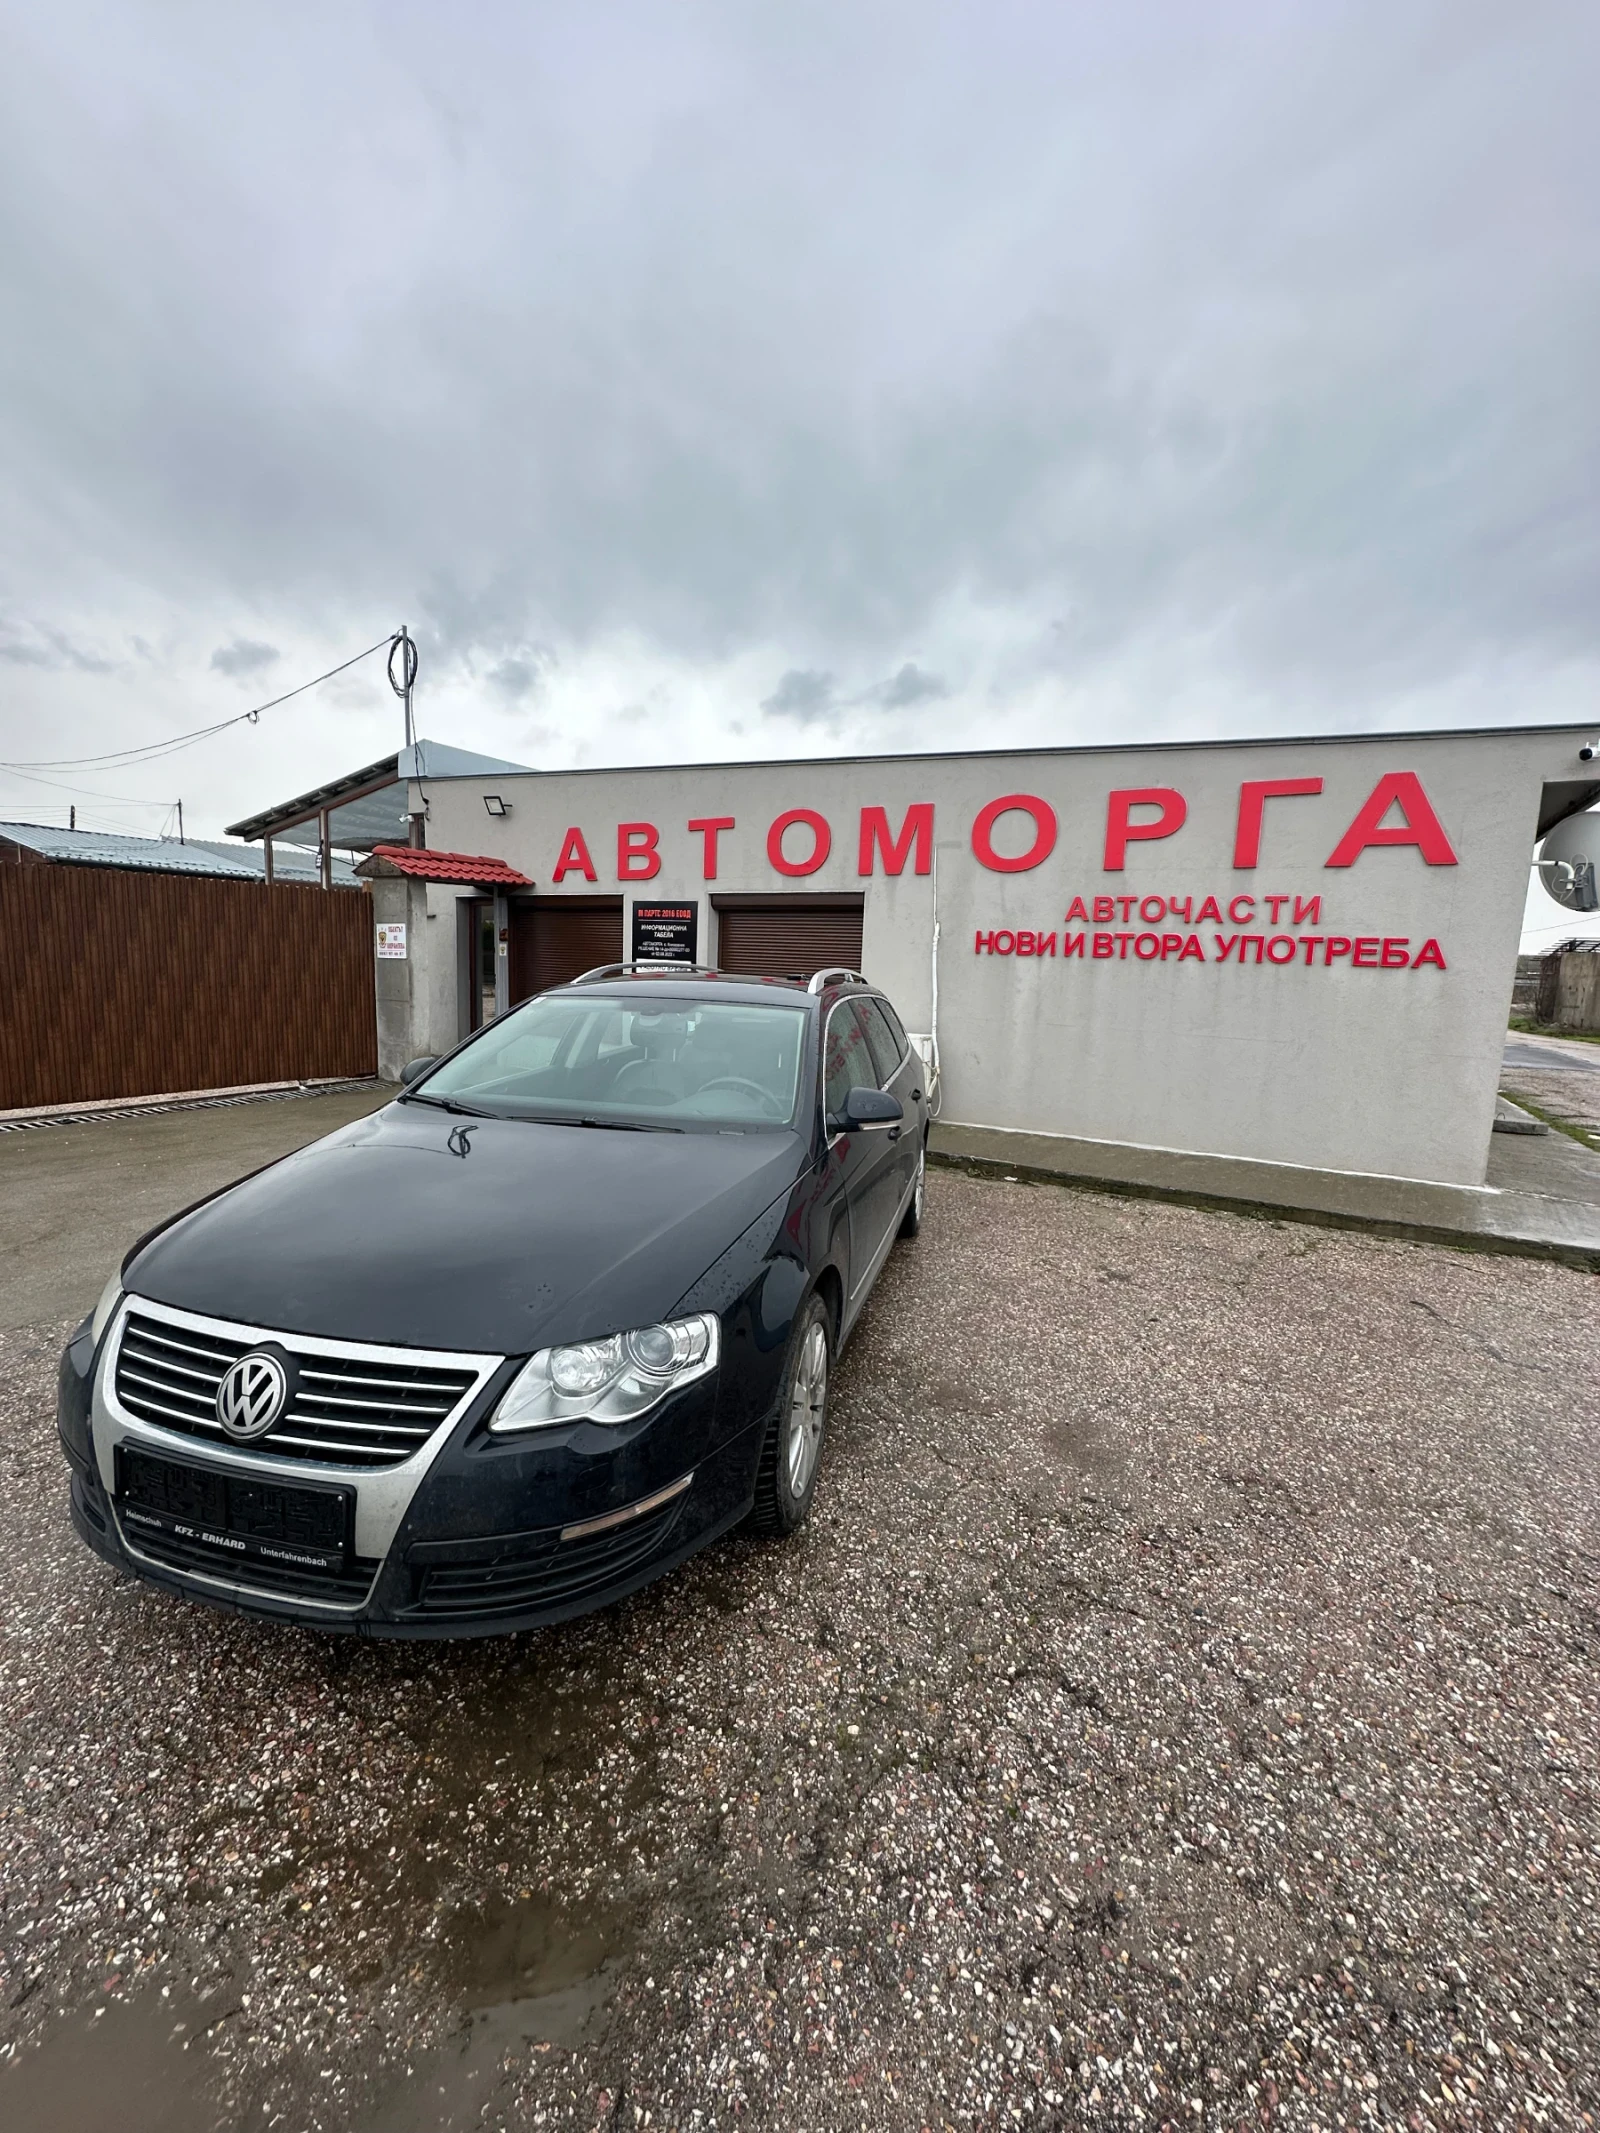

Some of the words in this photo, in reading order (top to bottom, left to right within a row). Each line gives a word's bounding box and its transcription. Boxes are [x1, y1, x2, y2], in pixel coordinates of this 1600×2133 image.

[552, 771, 1458, 882] АВТОМОРГА
[1065, 895, 1321, 925] АВТОЧАСТИ
[974, 930, 1057, 958] НОВИ
[1063, 931, 1086, 959] И
[1093, 931, 1206, 962] ВТОРА
[1214, 934, 1447, 969] УПОТРЕБА
[125, 1509, 162, 1528] Heimschuh
[174, 1524, 194, 1537] KFZ
[202, 1532, 246, 1550] ERHARD
[260, 1547, 327, 1567] Unterfahrenbach
